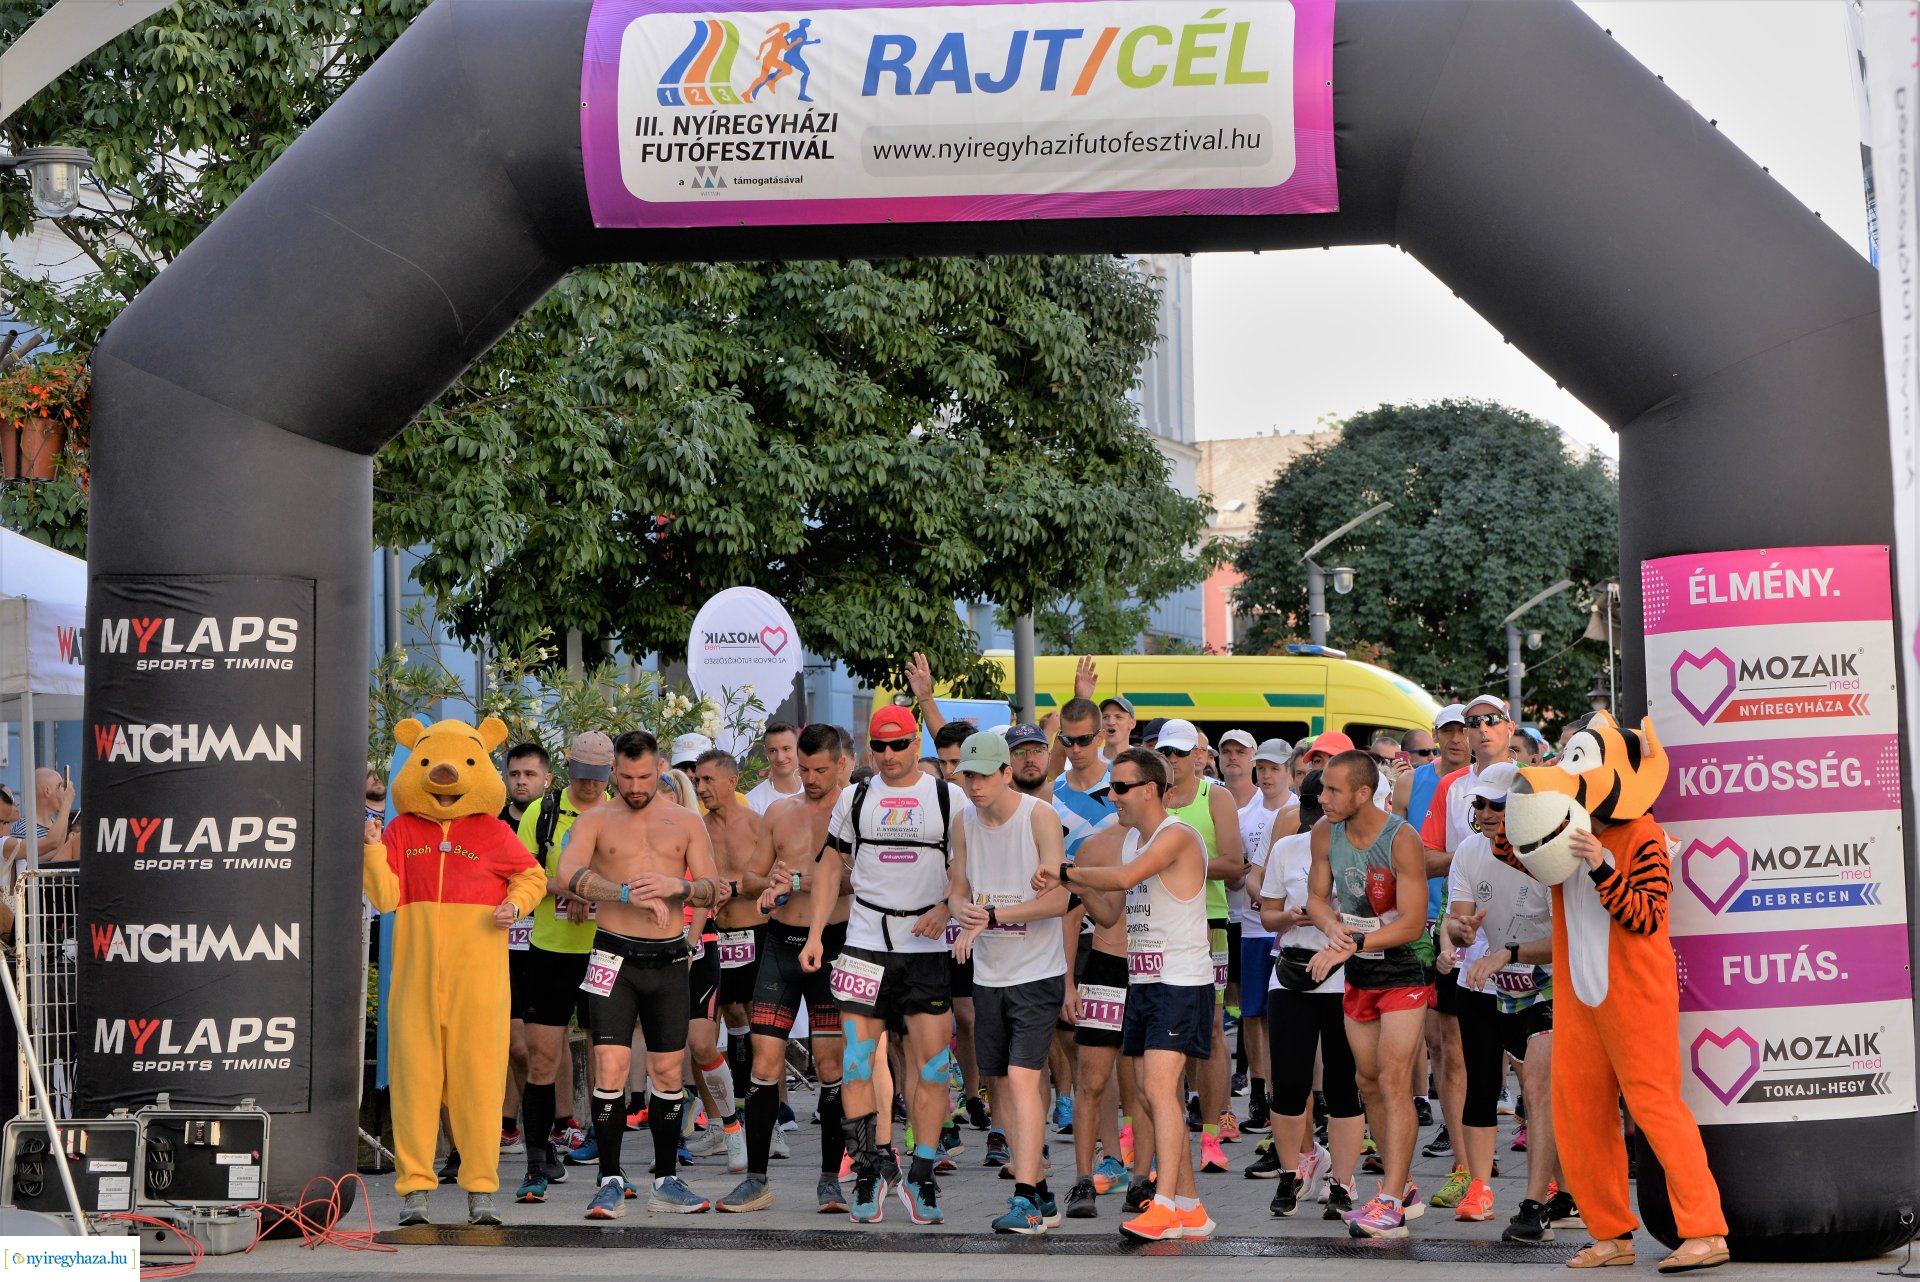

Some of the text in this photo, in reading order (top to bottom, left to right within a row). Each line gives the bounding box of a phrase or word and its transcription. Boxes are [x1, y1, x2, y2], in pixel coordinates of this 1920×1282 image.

[861, 8, 1270, 97] RAJT/CÉL
[635, 107, 839, 137] III. NYÍREGYHÁZI
[641, 134, 835, 163] FUTÓFESZTIVÁL
[872, 128, 1262, 164] www.nyiregyhazifutofesztival.hu
[734, 175, 804, 186] támogatásával
[1688, 562, 1841, 606] ÉLMÉNY.
[100, 616, 298, 654] MYLAPS
[136, 658, 294, 671] SPORTS TIMING
[1738, 653, 1858, 682] MOZAIK
[1828, 678, 1860, 690] med
[1739, 698, 1844, 717] NYÍREGYHÁZA
[94, 723, 302, 763] WATCHMAN
[1678, 750, 1871, 797] KÖZÖSSÉG.
[96, 816, 297, 853] MYLAPS
[134, 858, 292, 871] SPORTS TIMING
[454, 844, 480, 862] Bear
[1751, 842, 1870, 872] MOZAIK
[1841, 867, 1872, 880] med
[1752, 890, 1850, 907] DEBRECEN
[90, 922, 300, 964] WATCHMAN
[1722, 944, 1848, 986] FUTÁS.
[830, 970, 877, 998] 21036
[94, 1016, 296, 1054] MYLAPS
[1762, 1032, 1880, 1062] MOZAIK
[132, 1058, 291, 1072] SPORTS TIMING
[1852, 1056, 1882, 1070] med
[1762, 1080, 1866, 1098] TOKAJI-HEGY
